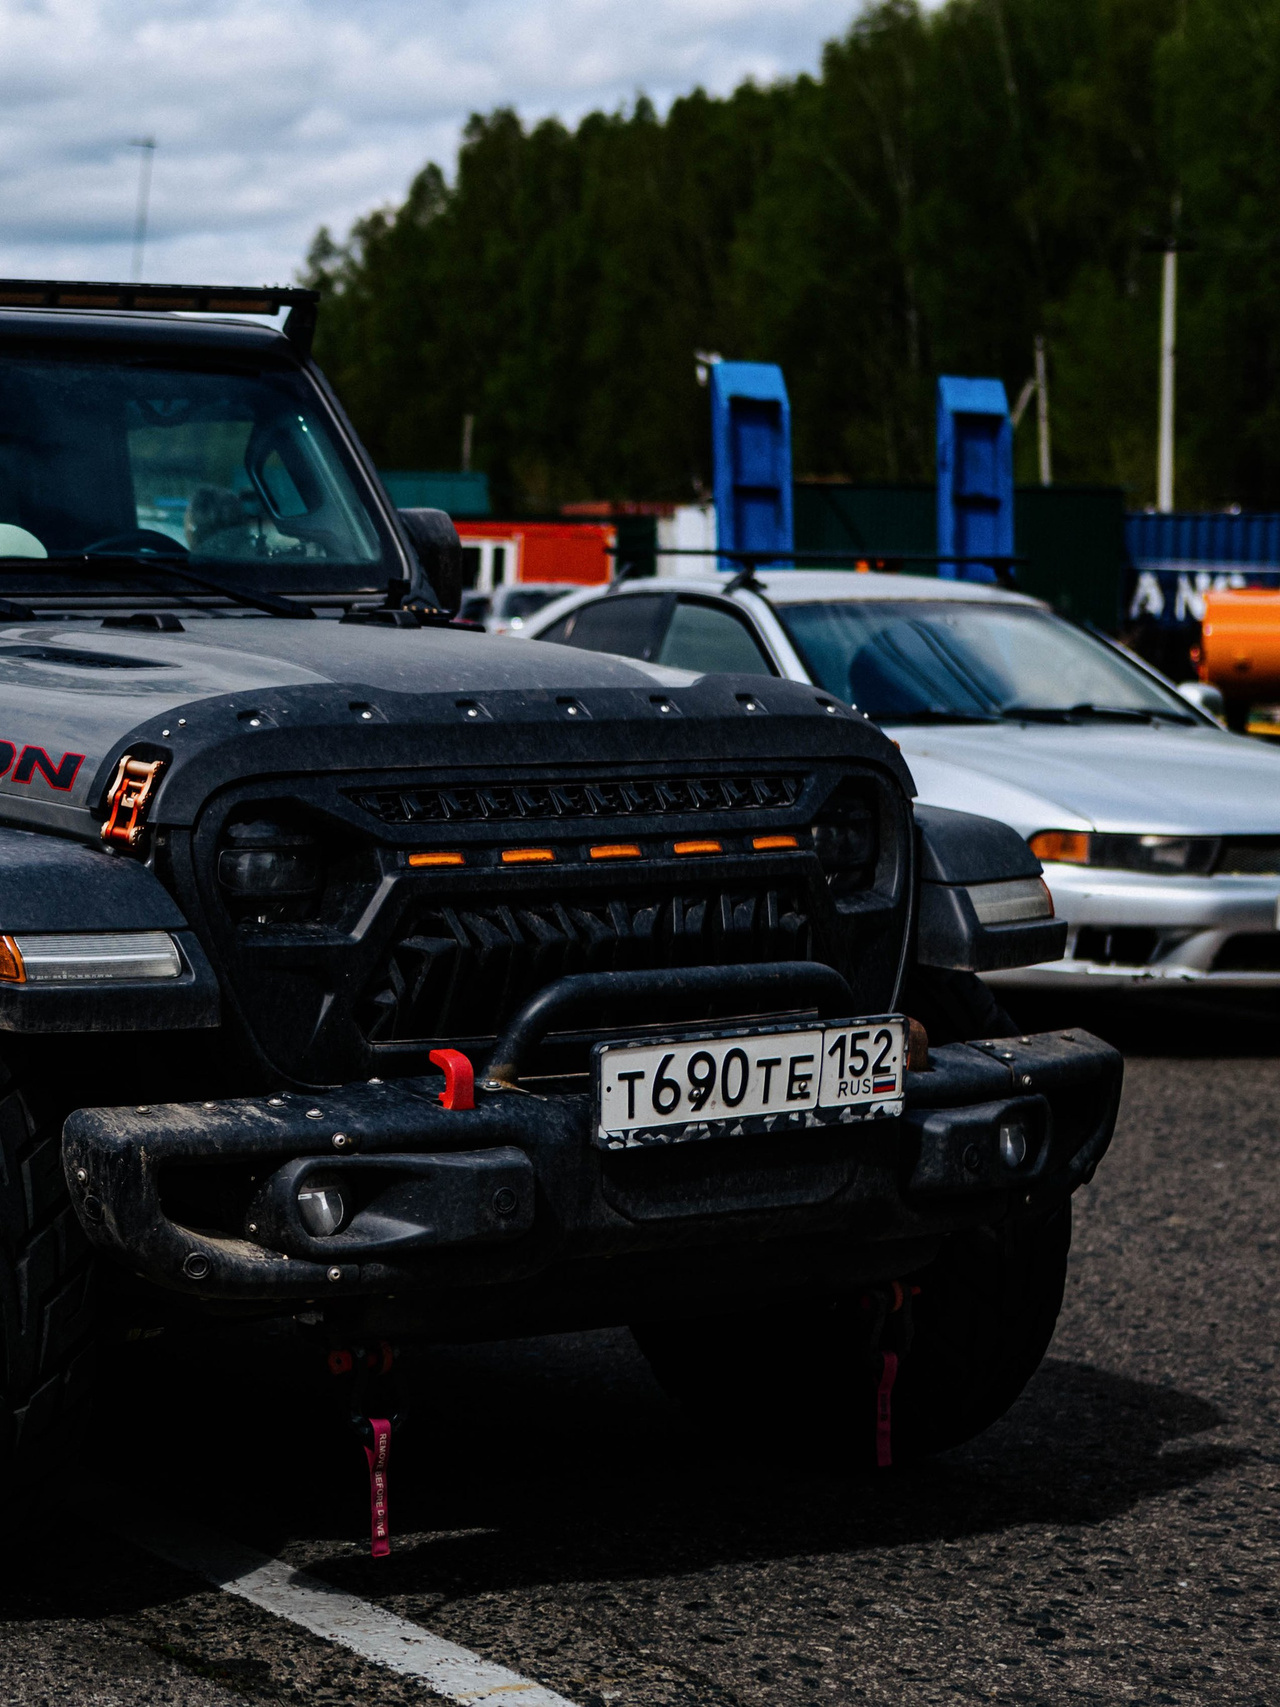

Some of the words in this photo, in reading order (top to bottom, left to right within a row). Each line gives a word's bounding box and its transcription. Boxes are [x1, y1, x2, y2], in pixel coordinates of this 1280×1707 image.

[827, 1028, 893, 1079] 152
[837, 1078, 871, 1098] RUS
[376, 1433, 387, 1469] REMOVE
[375, 1471, 384, 1508] BEFORE
[377, 1509, 385, 1537] DRIVE
